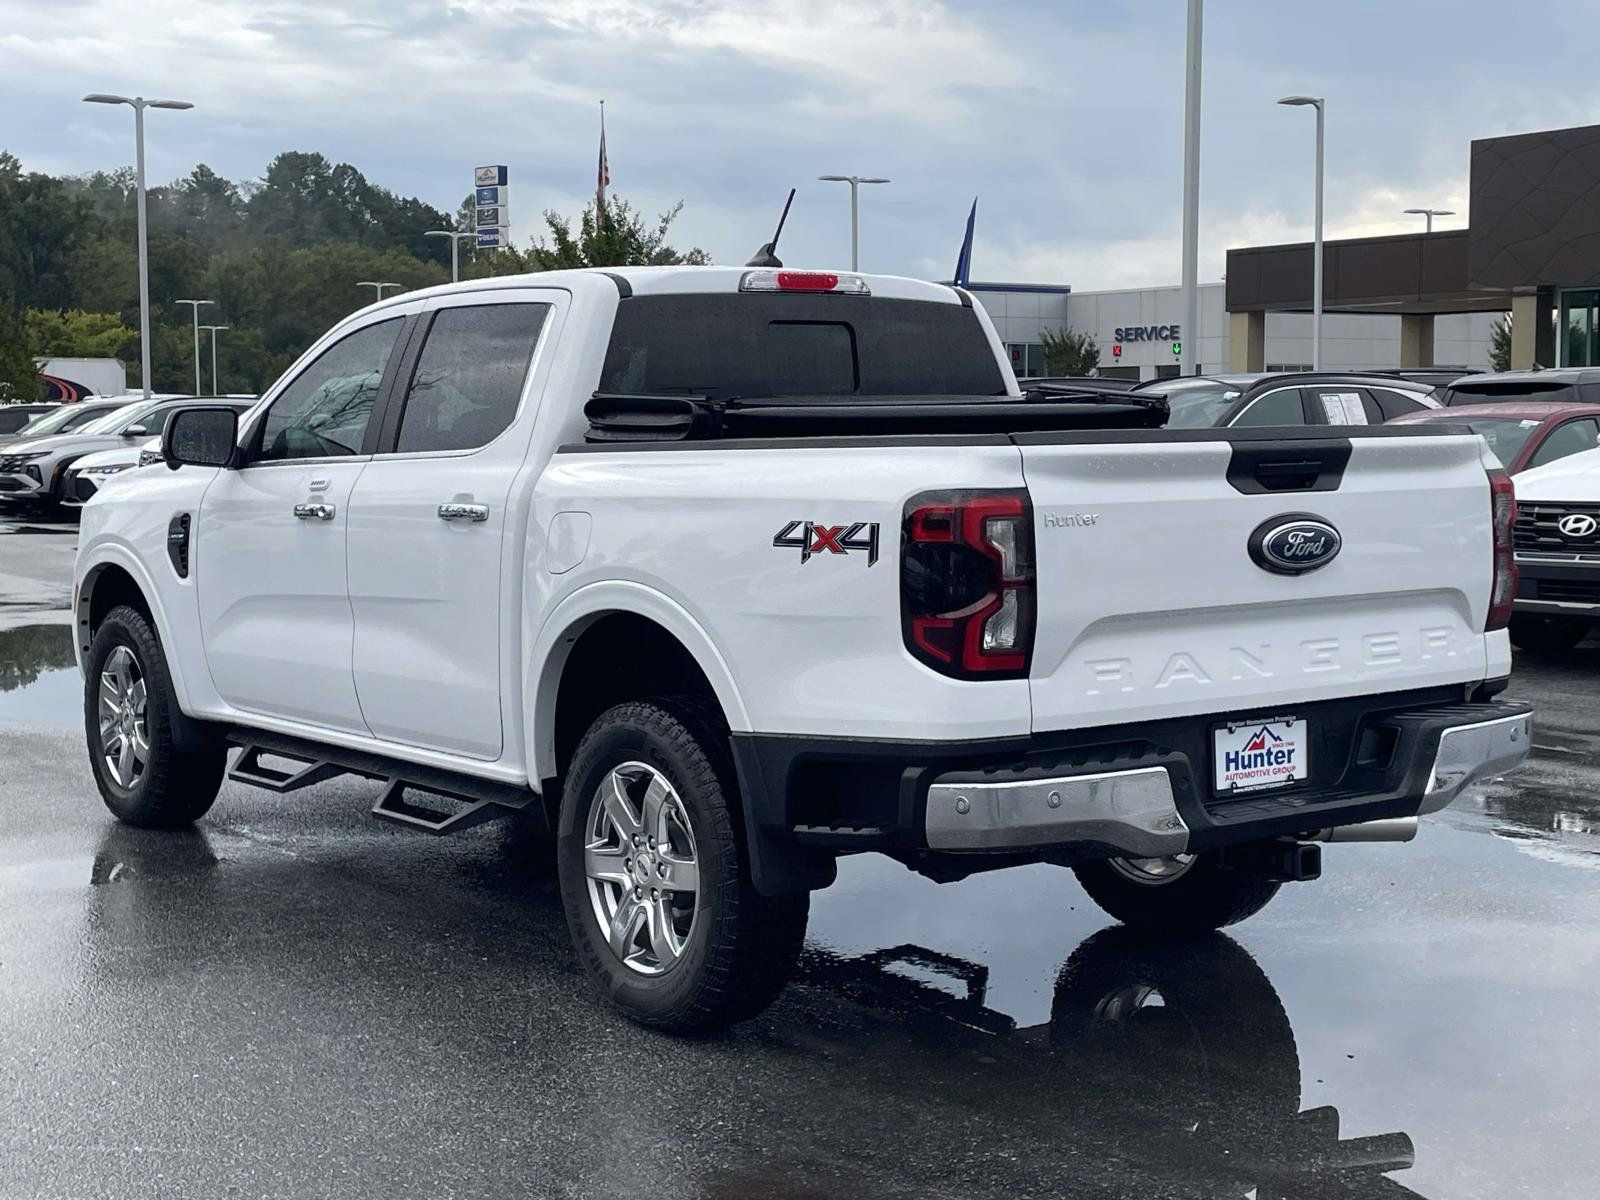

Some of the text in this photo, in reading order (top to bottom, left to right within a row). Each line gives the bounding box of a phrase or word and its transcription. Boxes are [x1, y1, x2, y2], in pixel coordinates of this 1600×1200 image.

[1114, 325, 1181, 342] SERVICE
[1044, 512, 1100, 528] Hunter
[1284, 531, 1326, 557] Ford
[1084, 626, 1456, 695] RANGER
[1226, 747, 1295, 771] Hunter
[1225, 766, 1296, 781] AUTOMOTIVE GROUP
